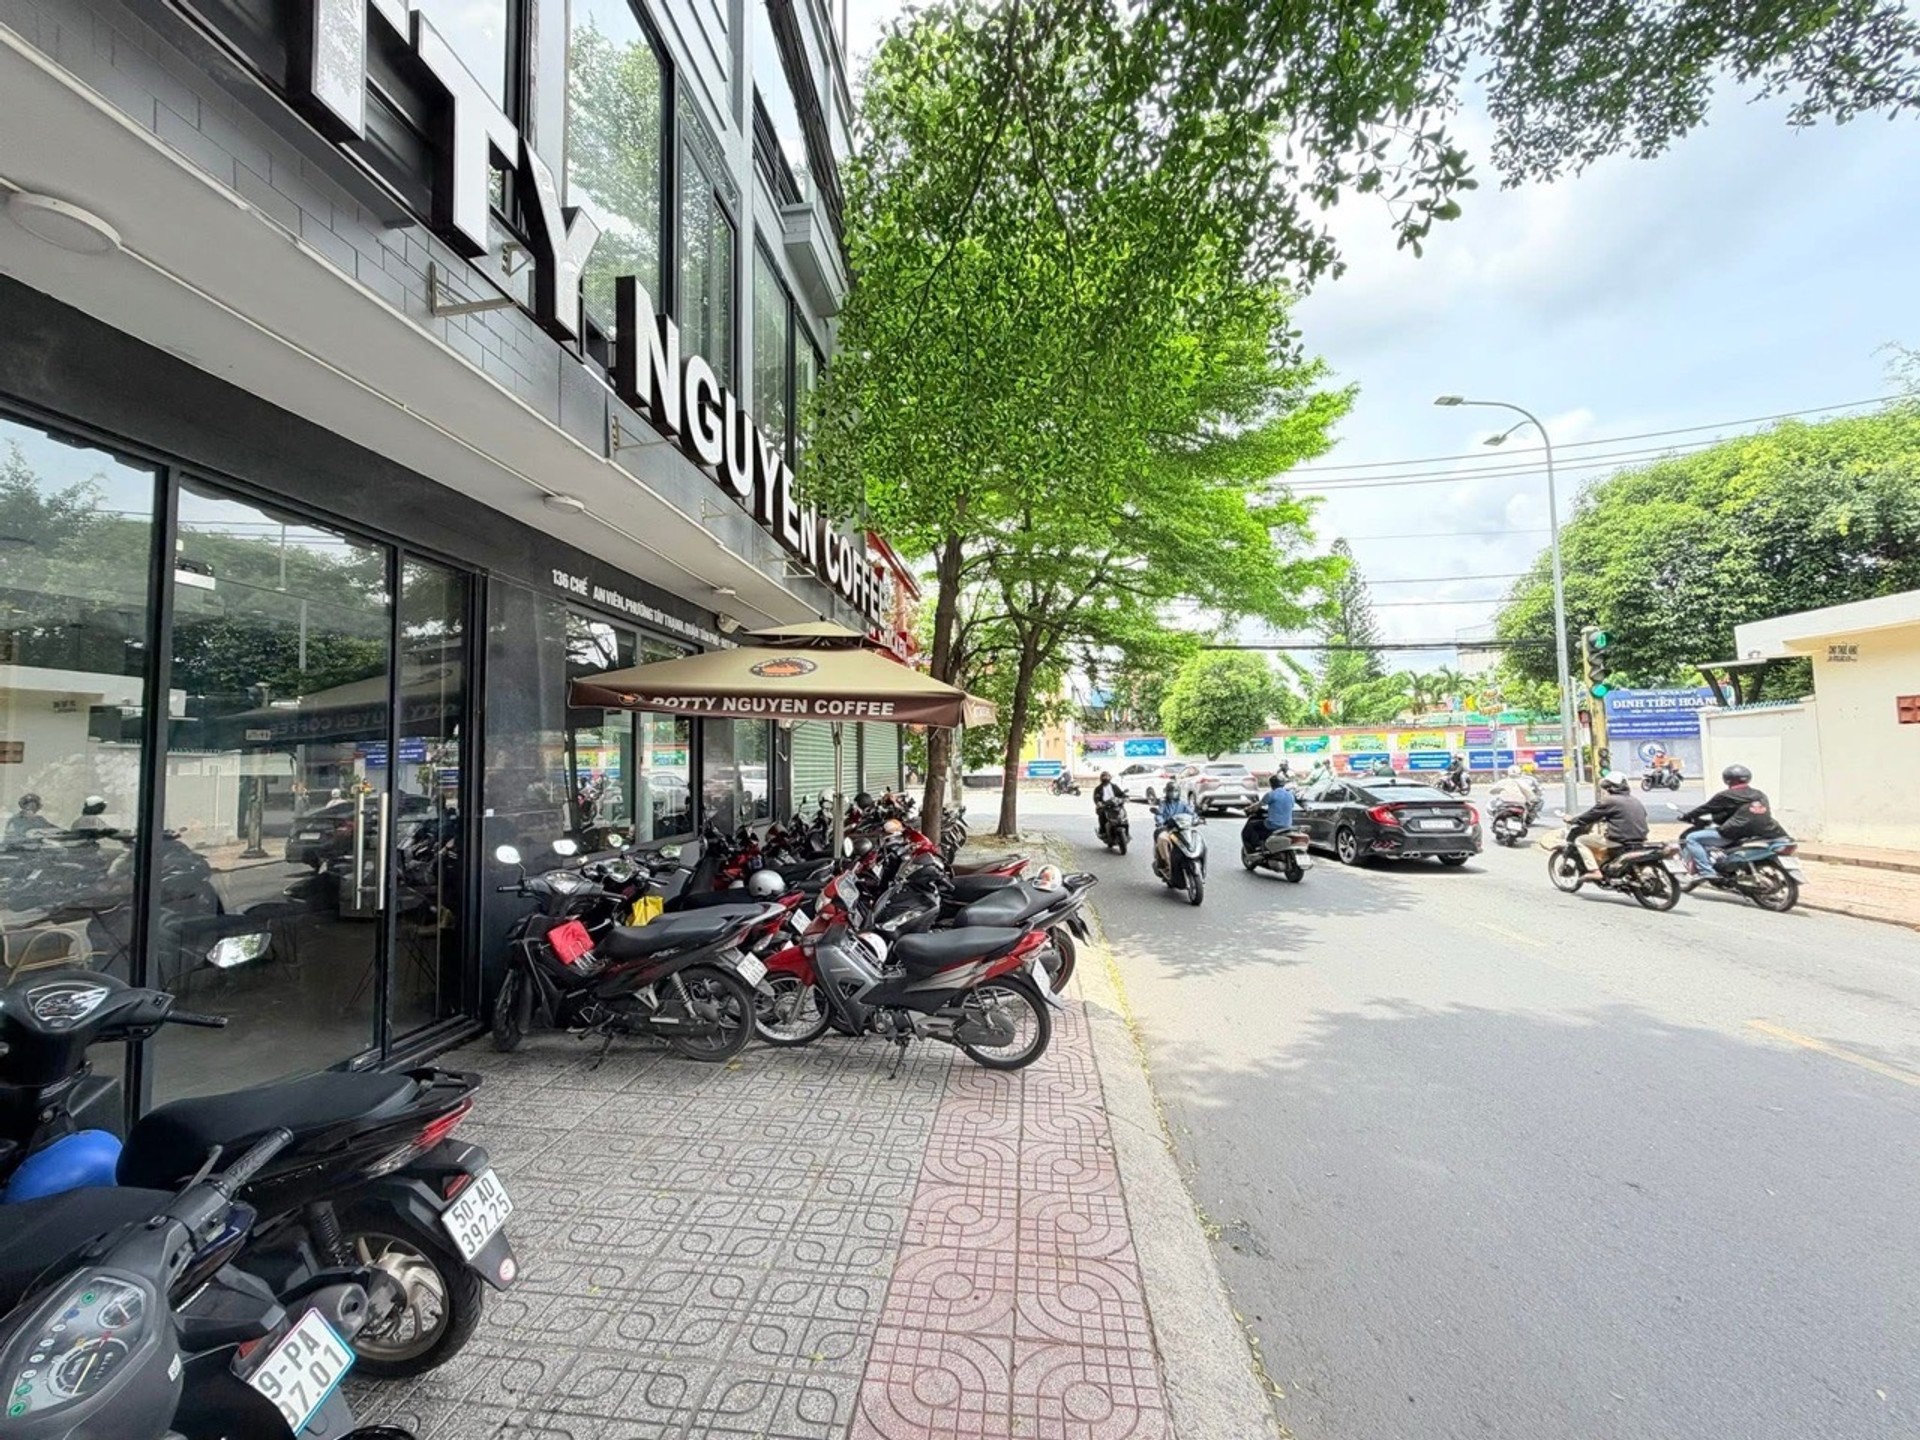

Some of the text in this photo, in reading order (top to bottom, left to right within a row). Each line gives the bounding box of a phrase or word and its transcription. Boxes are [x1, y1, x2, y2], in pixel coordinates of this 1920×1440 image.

[634, 275, 817, 567] NGUYEN
[825, 519, 890, 632] COFFEE
[552, 569, 569, 589] 136
[722, 697, 807, 713] NGUYEN
[814, 700, 896, 716] COFFEE
[451, 1177, 495, 1229] 50-AD
[461, 1193, 510, 1255] 392.25
[258, 1328, 322, 1399] 9-PA
[278, 1344, 344, 1427] 97.01
